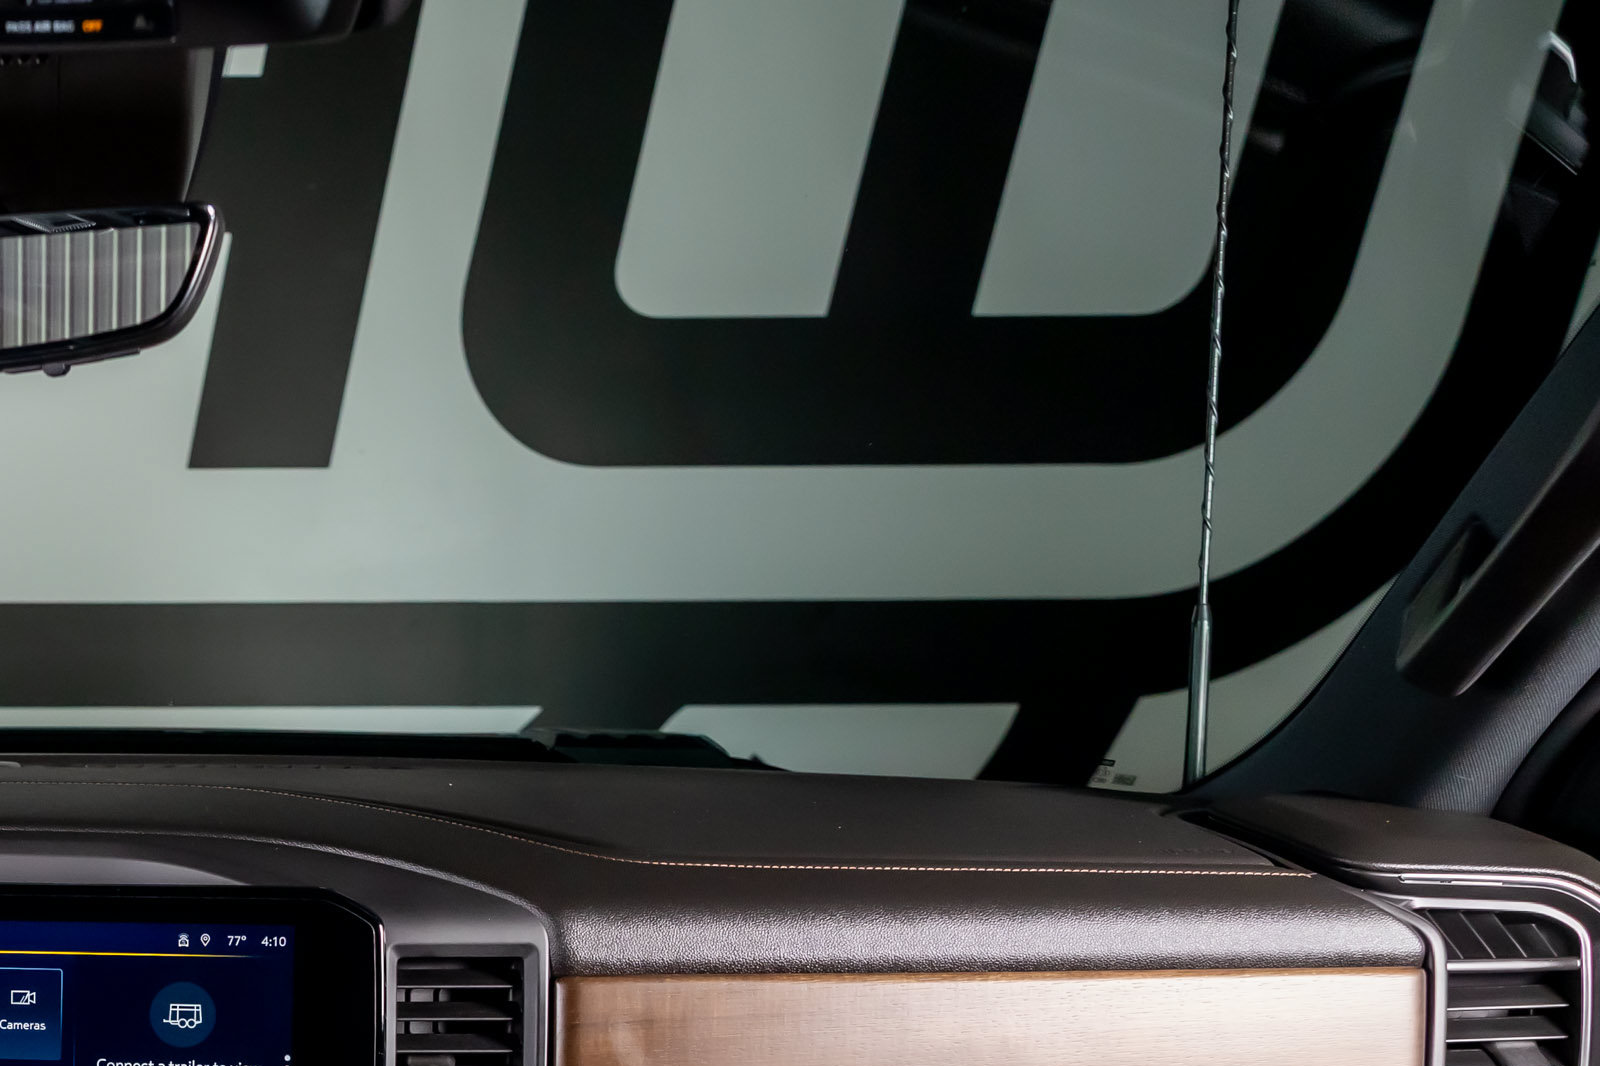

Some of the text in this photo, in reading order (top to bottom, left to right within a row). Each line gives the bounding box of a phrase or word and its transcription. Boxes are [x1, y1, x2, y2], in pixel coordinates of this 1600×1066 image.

[227, 935, 288, 948] 77° 4:10
[0, 1019, 47, 1031] Cameras
